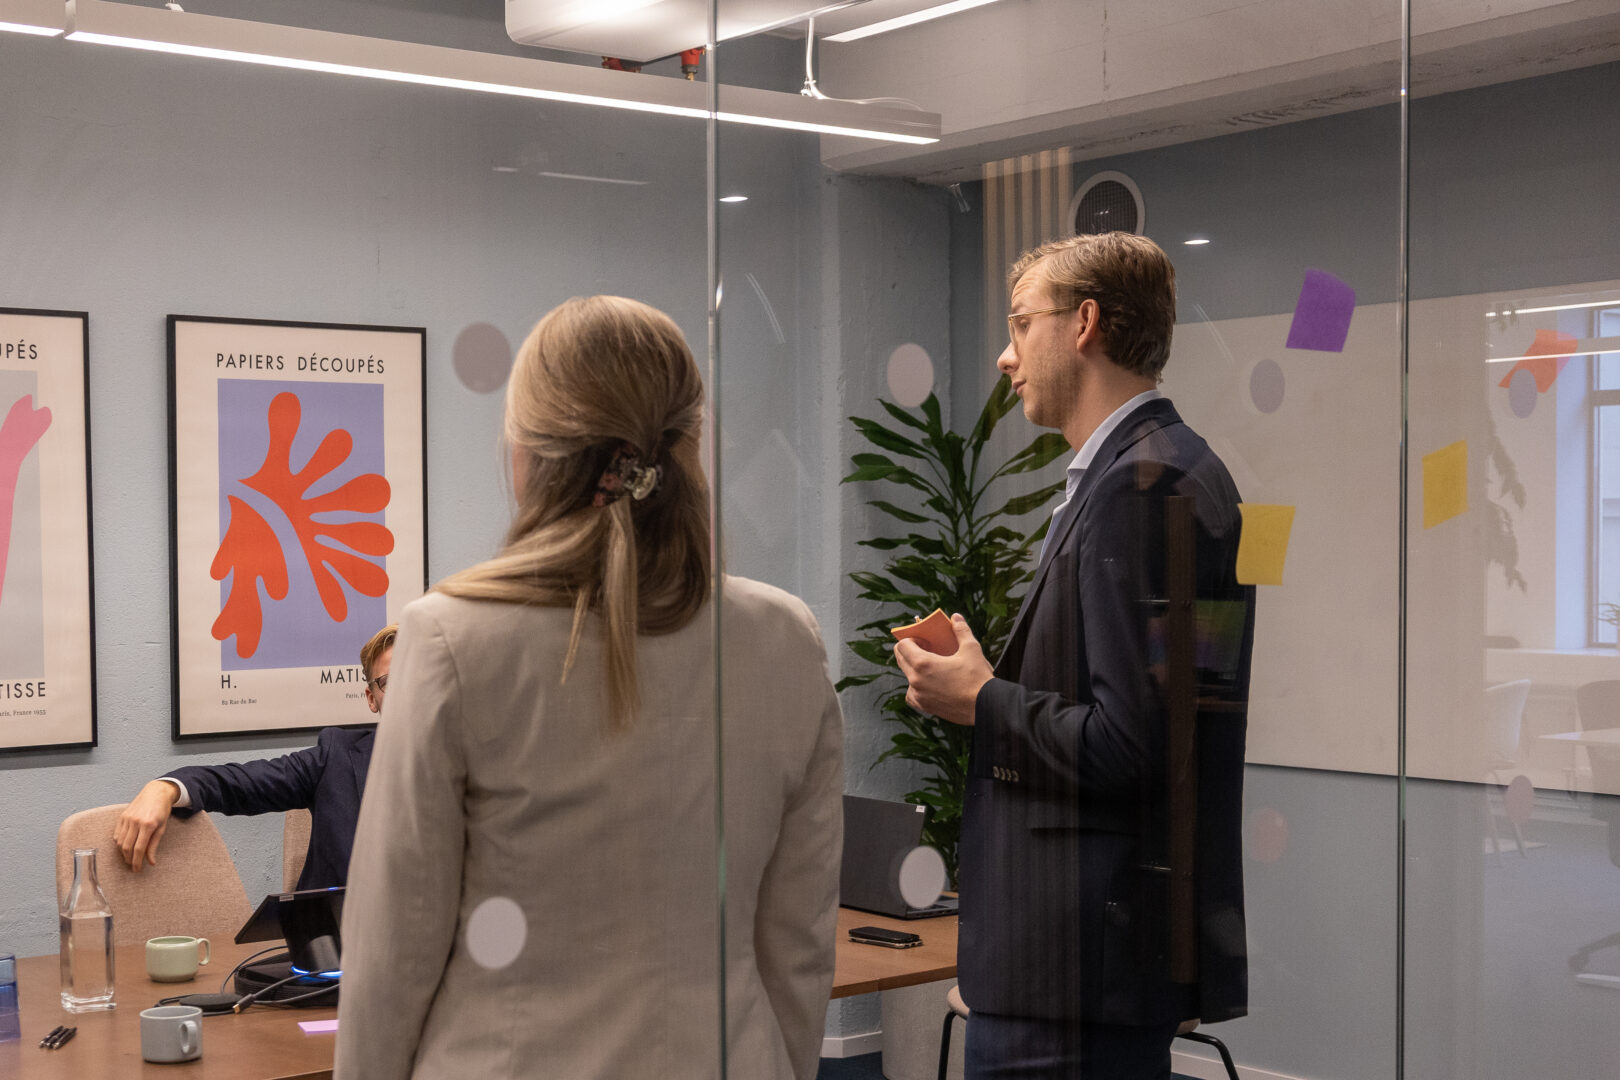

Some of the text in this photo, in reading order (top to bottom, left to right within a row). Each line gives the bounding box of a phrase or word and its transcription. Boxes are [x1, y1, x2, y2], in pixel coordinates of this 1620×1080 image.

[0, 339, 38, 360] PÉS
[216, 352, 385, 374] PAPIERS DÉCOUPÉS
[221, 674, 237, 689] H.
